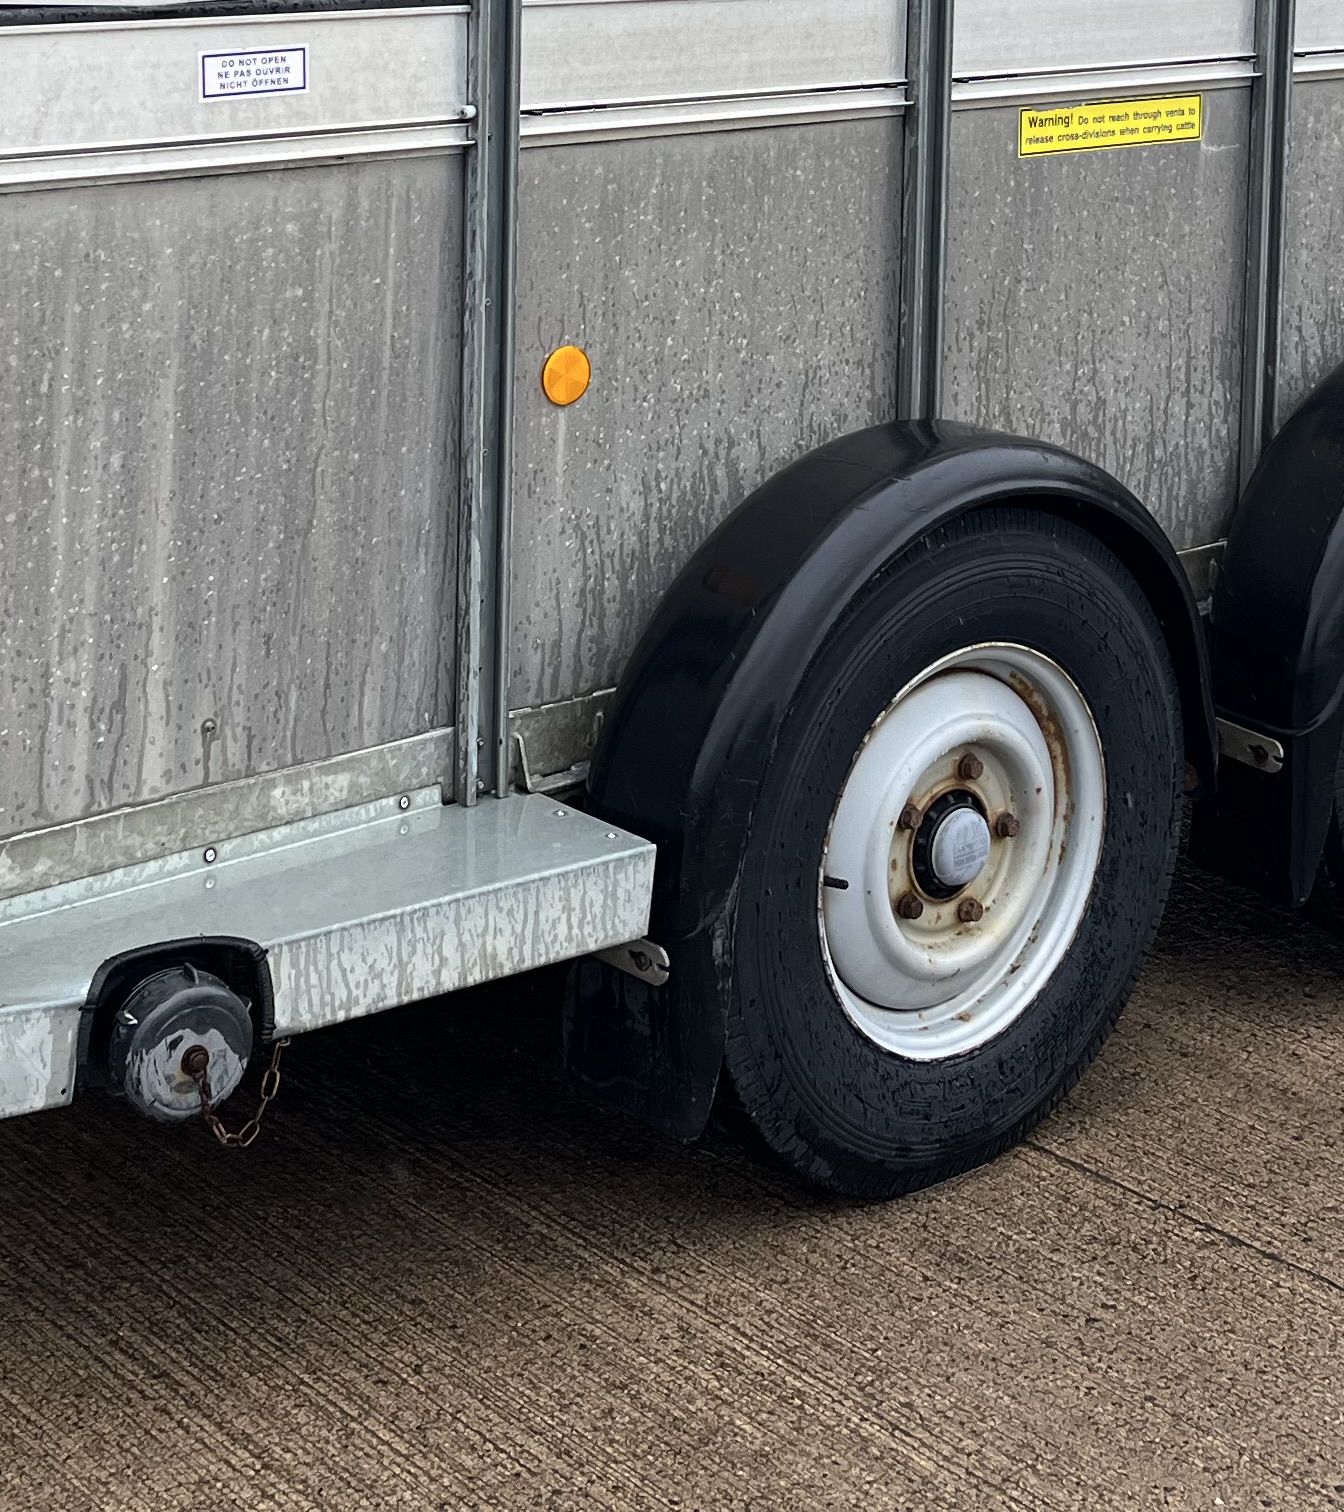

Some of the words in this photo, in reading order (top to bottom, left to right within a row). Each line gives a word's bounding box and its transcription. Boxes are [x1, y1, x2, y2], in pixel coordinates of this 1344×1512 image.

[221, 59, 235, 68] DO
[238, 57, 258, 67] NOT
[261, 56, 287, 64] OPEN
[217, 71, 230, 79] NE
[233, 69, 252, 78] PAS
[255, 66, 291, 77] OUVRIR
[219, 80, 248, 90] NICHT
[251, 77, 289, 88] ÖFFNEN
[1028, 113, 1074, 129] Warning!
[1078, 115, 1089, 125] Do
[1092, 114, 1105, 124] not
[1109, 112, 1129, 122] reach
[1133, 110, 1162, 122] through
[1189, 107, 1196, 116] to
[1025, 134, 1053, 145] release
[1057, 129, 1116, 143] cross-divisions
[1120, 126, 1139, 136] when
[1143, 123, 1173, 135] carrying
